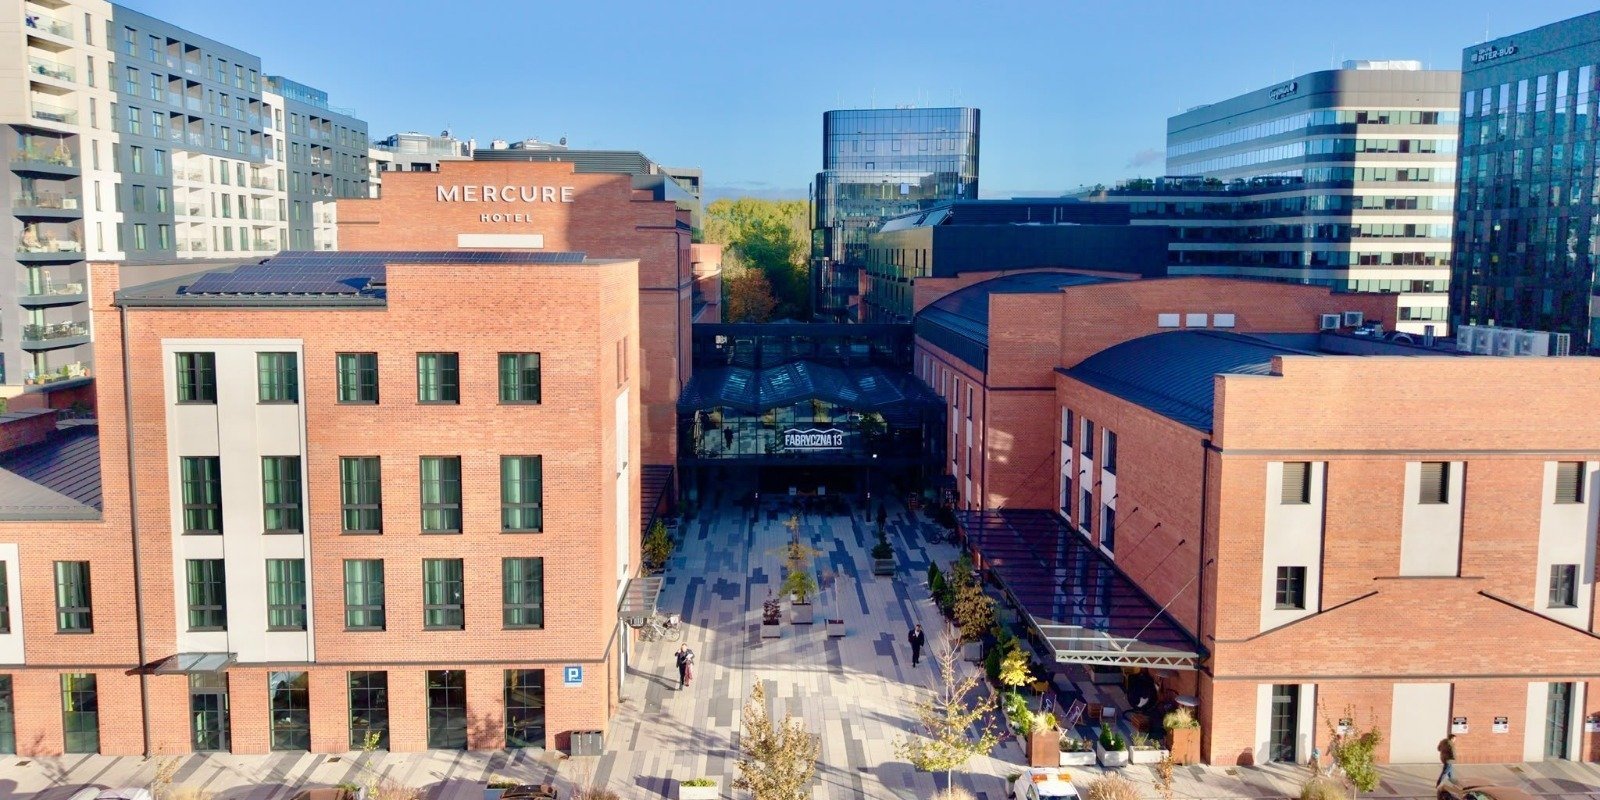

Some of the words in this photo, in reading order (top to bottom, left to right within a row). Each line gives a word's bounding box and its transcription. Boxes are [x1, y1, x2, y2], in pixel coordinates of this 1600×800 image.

[436, 185, 575, 202] MERCURE
[480, 213, 533, 222] HOTEL
[784, 434, 832, 446] FABRYCZNA
[833, 434, 843, 446] 13
[568, 668, 579, 681] P
